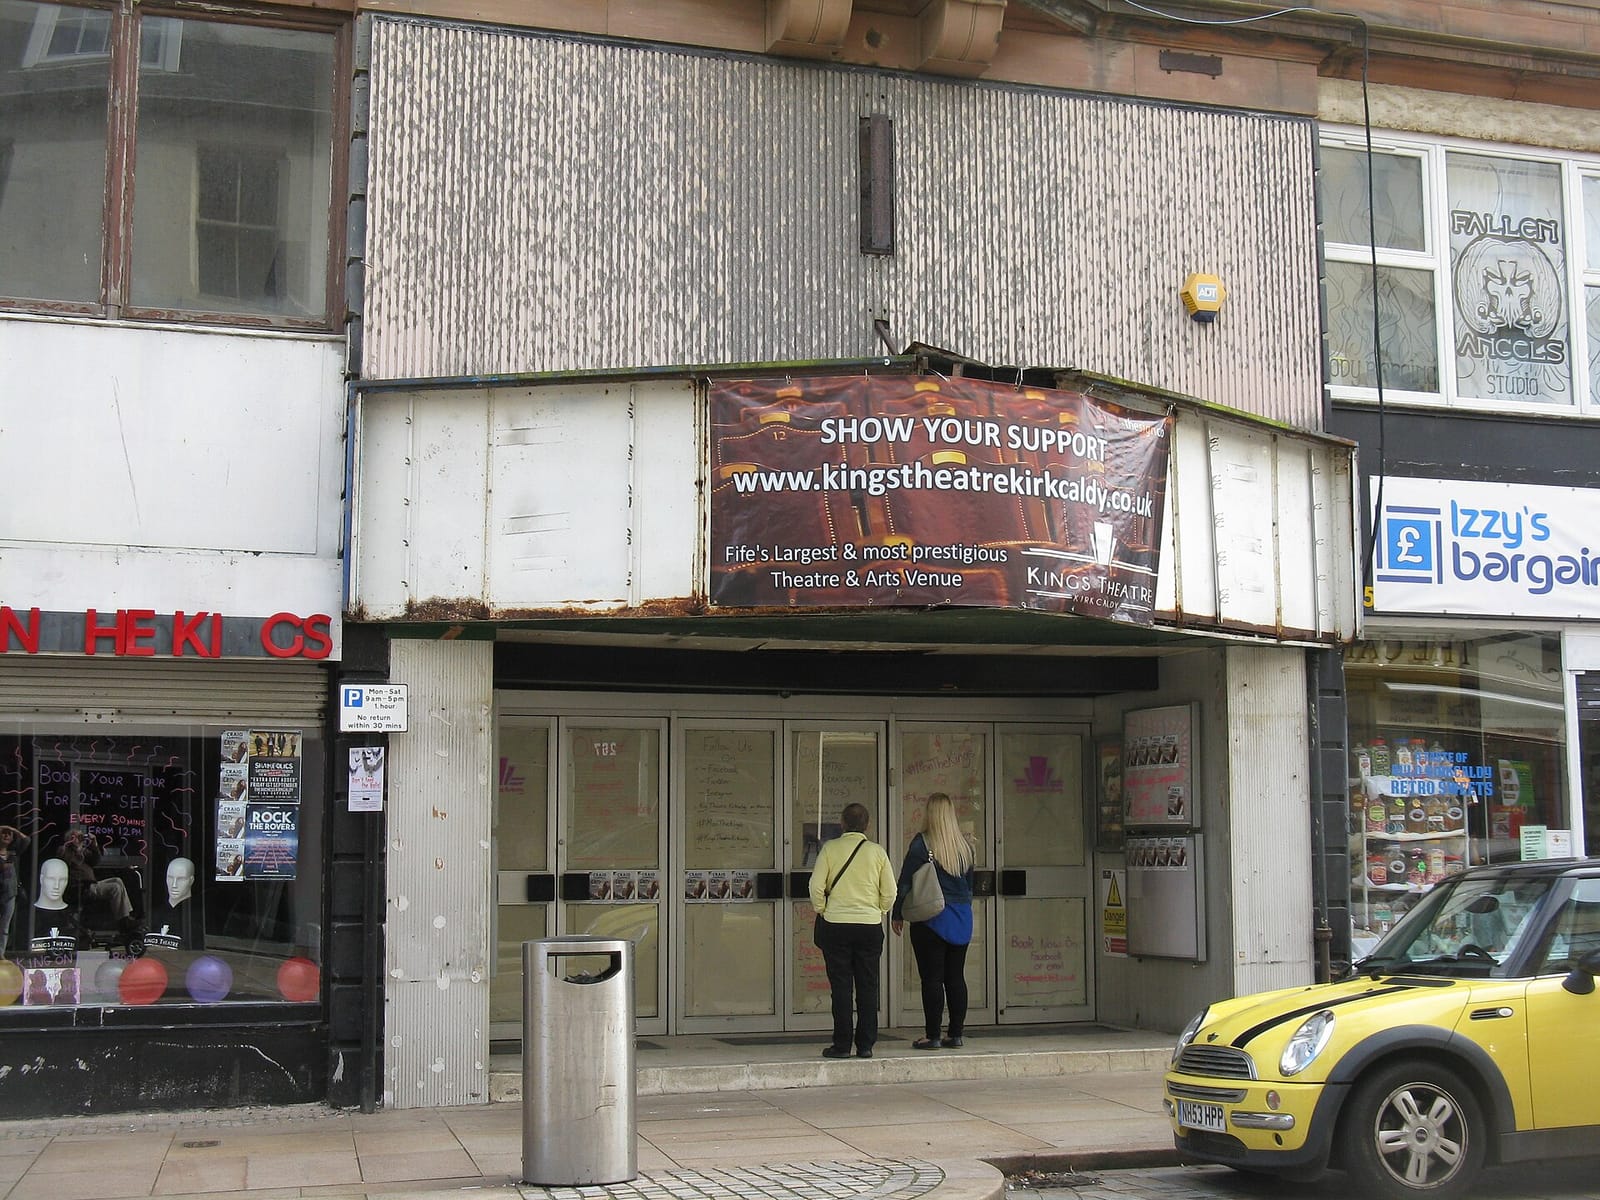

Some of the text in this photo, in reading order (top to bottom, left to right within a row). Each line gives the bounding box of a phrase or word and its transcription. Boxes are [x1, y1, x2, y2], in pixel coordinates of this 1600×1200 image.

[820, 417, 1107, 462] SHOW YOUR SUPPORT
[733, 463, 1154, 519] www.kingstheatrekirkcaldy.co.uk
[1450, 499, 1551, 549] Izzy's
[724, 544, 1008, 567] Fife's Largest & most prestigious
[771, 570, 962, 588] Theatre & Arts Venue
[1027, 567, 1153, 604] KINGS THEATRE
[1455, 752, 1468, 763] OF
[39, 763, 166, 788] BOOK YOUR TOUR
[1391, 780, 1435, 795] RETRO
[45, 790, 69, 806] FOR
[119, 794, 160, 809] SEPT
[69, 813, 107, 824] EVERY
[249, 822, 296, 831] THE ROVERS
[252, 811, 293, 823] ROCK
[1182, 1102, 1224, 1127] NH53 HPP
